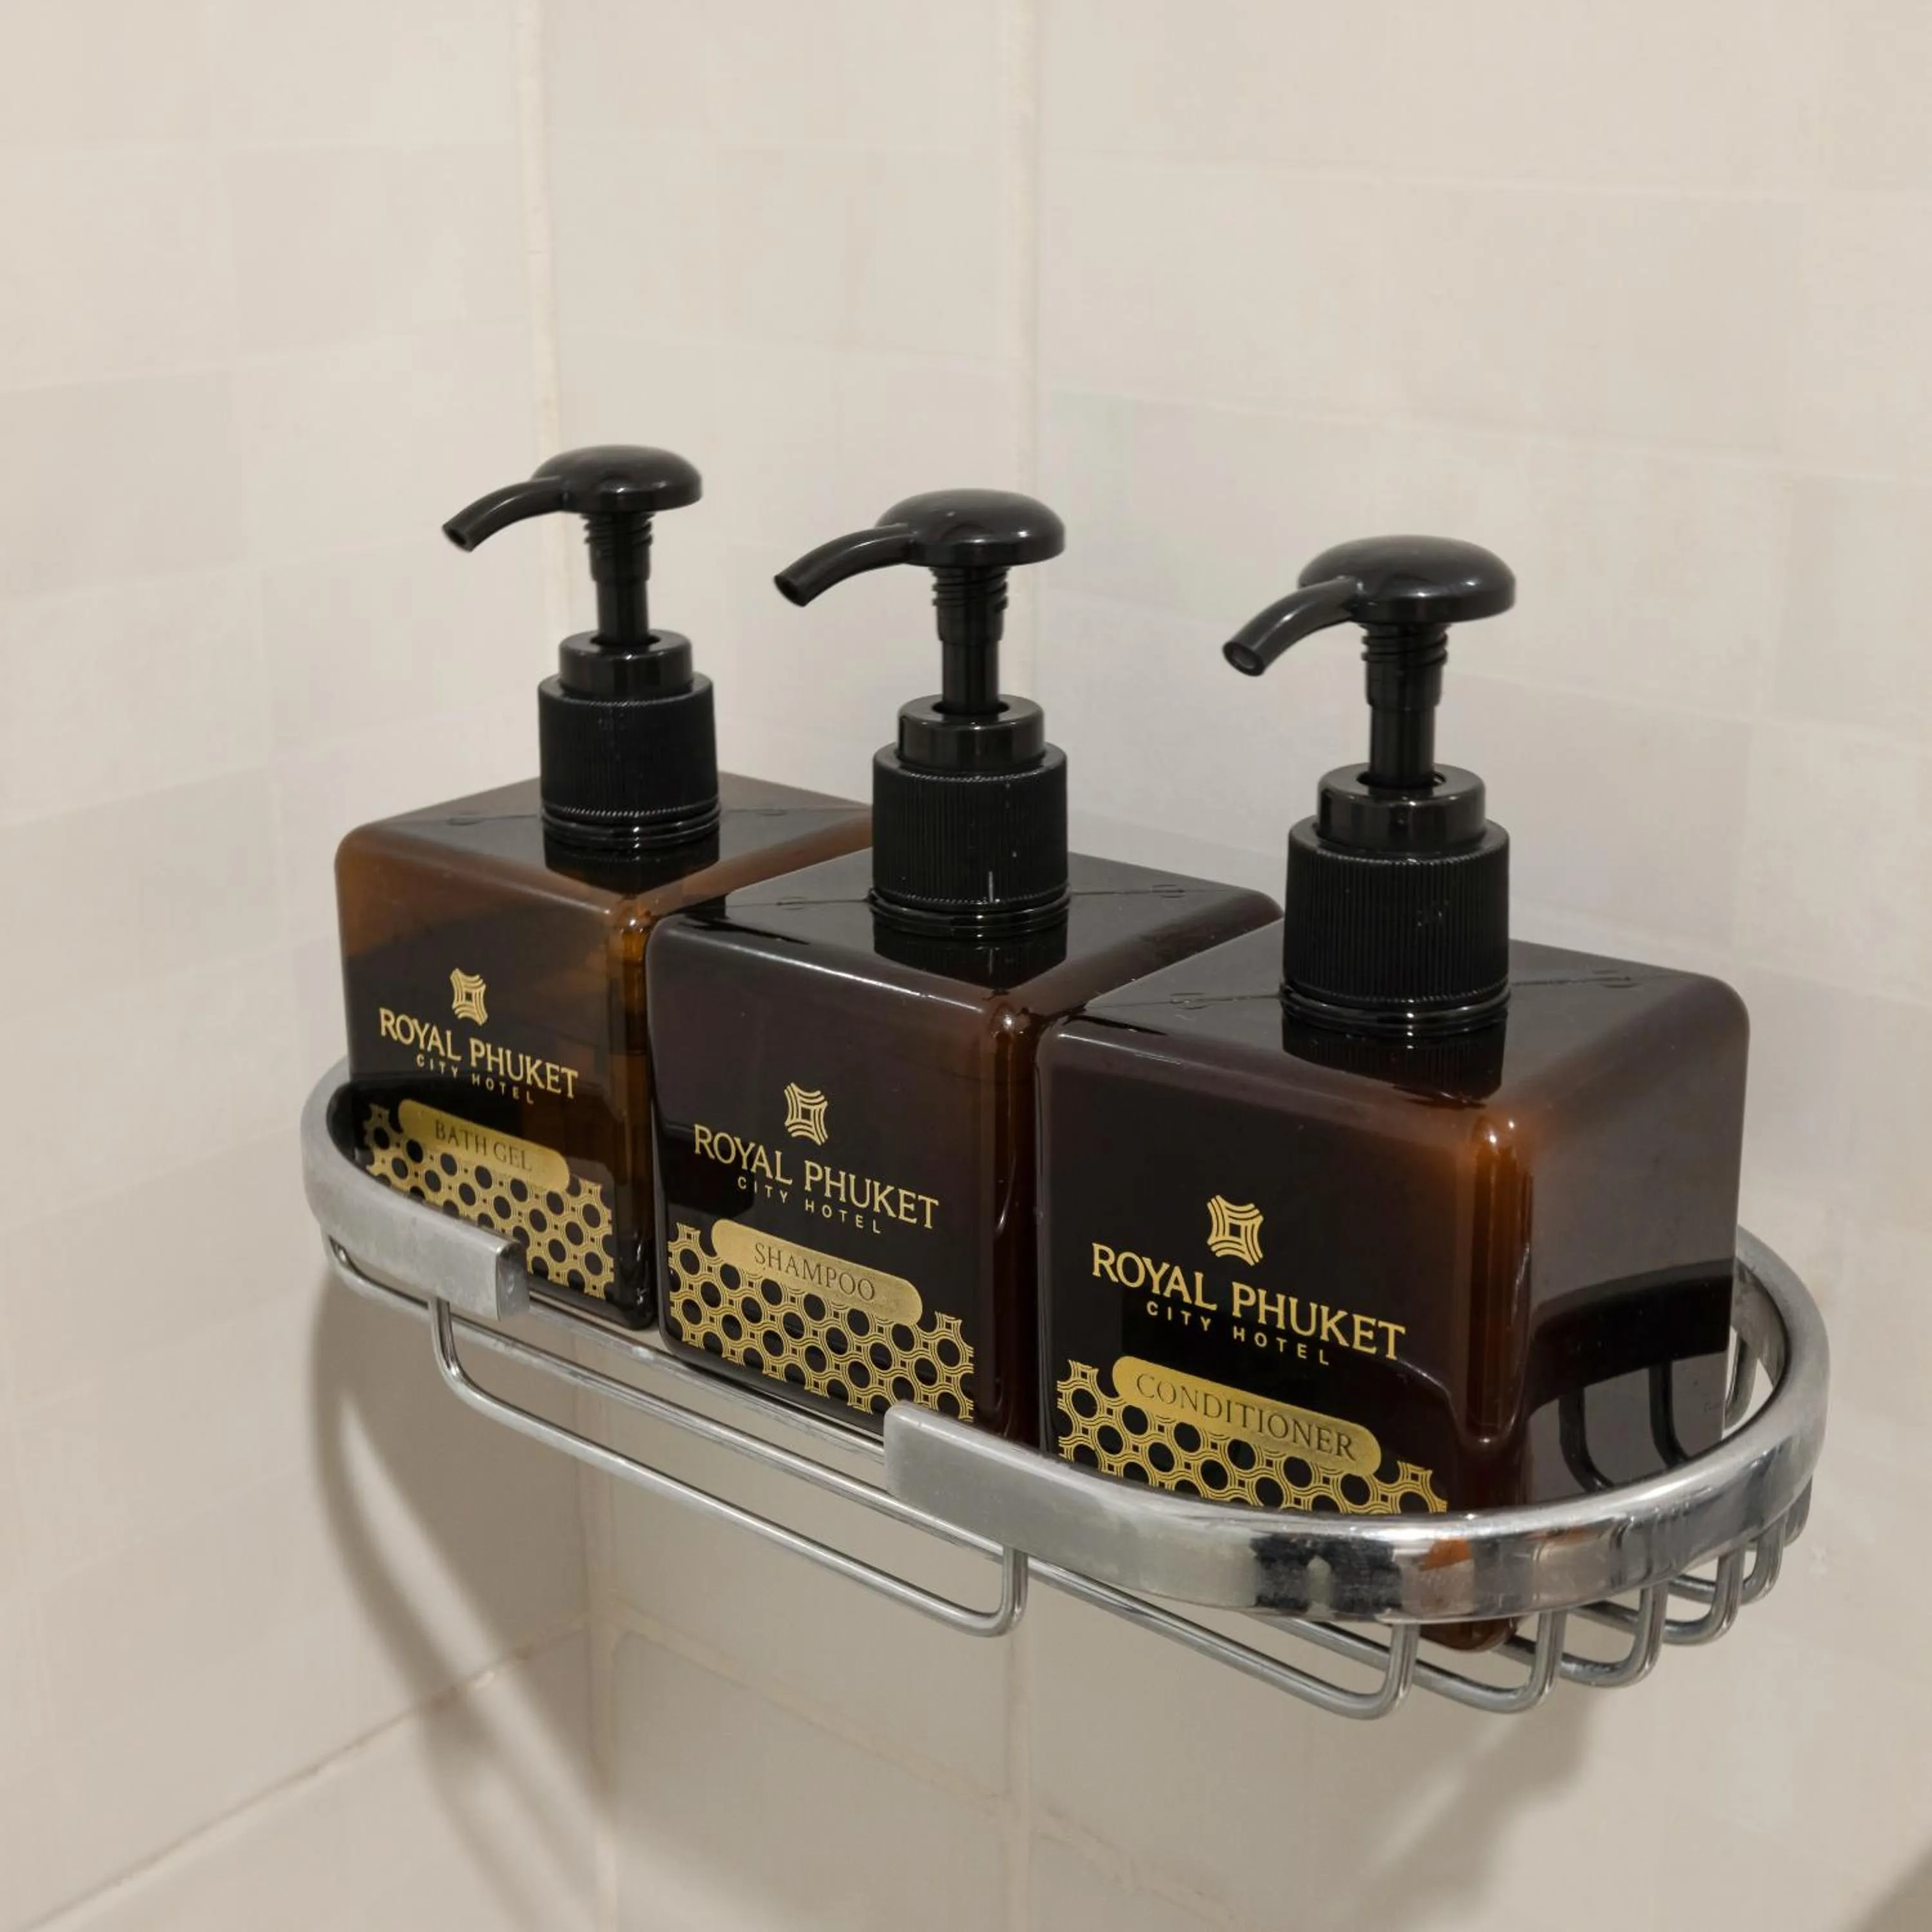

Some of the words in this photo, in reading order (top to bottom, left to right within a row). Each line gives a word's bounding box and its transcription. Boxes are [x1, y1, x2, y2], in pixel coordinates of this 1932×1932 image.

[379, 1007, 462, 1061] ROYAL
[469, 1037, 578, 1099] PHUKET
[417, 1056, 458, 1077] CITY
[472, 1074, 534, 1104] HOTEL
[435, 1119, 488, 1157] BATH
[493, 1141, 533, 1172] GEL
[694, 1124, 793, 1186] ROYAL
[804, 1160, 940, 1229] PHUKET
[738, 1177, 788, 1203] CITY
[805, 1198, 880, 1234] HOTEL
[754, 1242, 875, 1302] SHAMPOO
[1092, 1242, 1217, 1311] ROYAL
[1232, 1281, 1406, 1359] PHUKET
[1146, 1302, 1211, 1331] CITY
[1233, 1326, 1329, 1365] HOTEL
[1136, 1373, 1356, 1462] CONDITIONER
